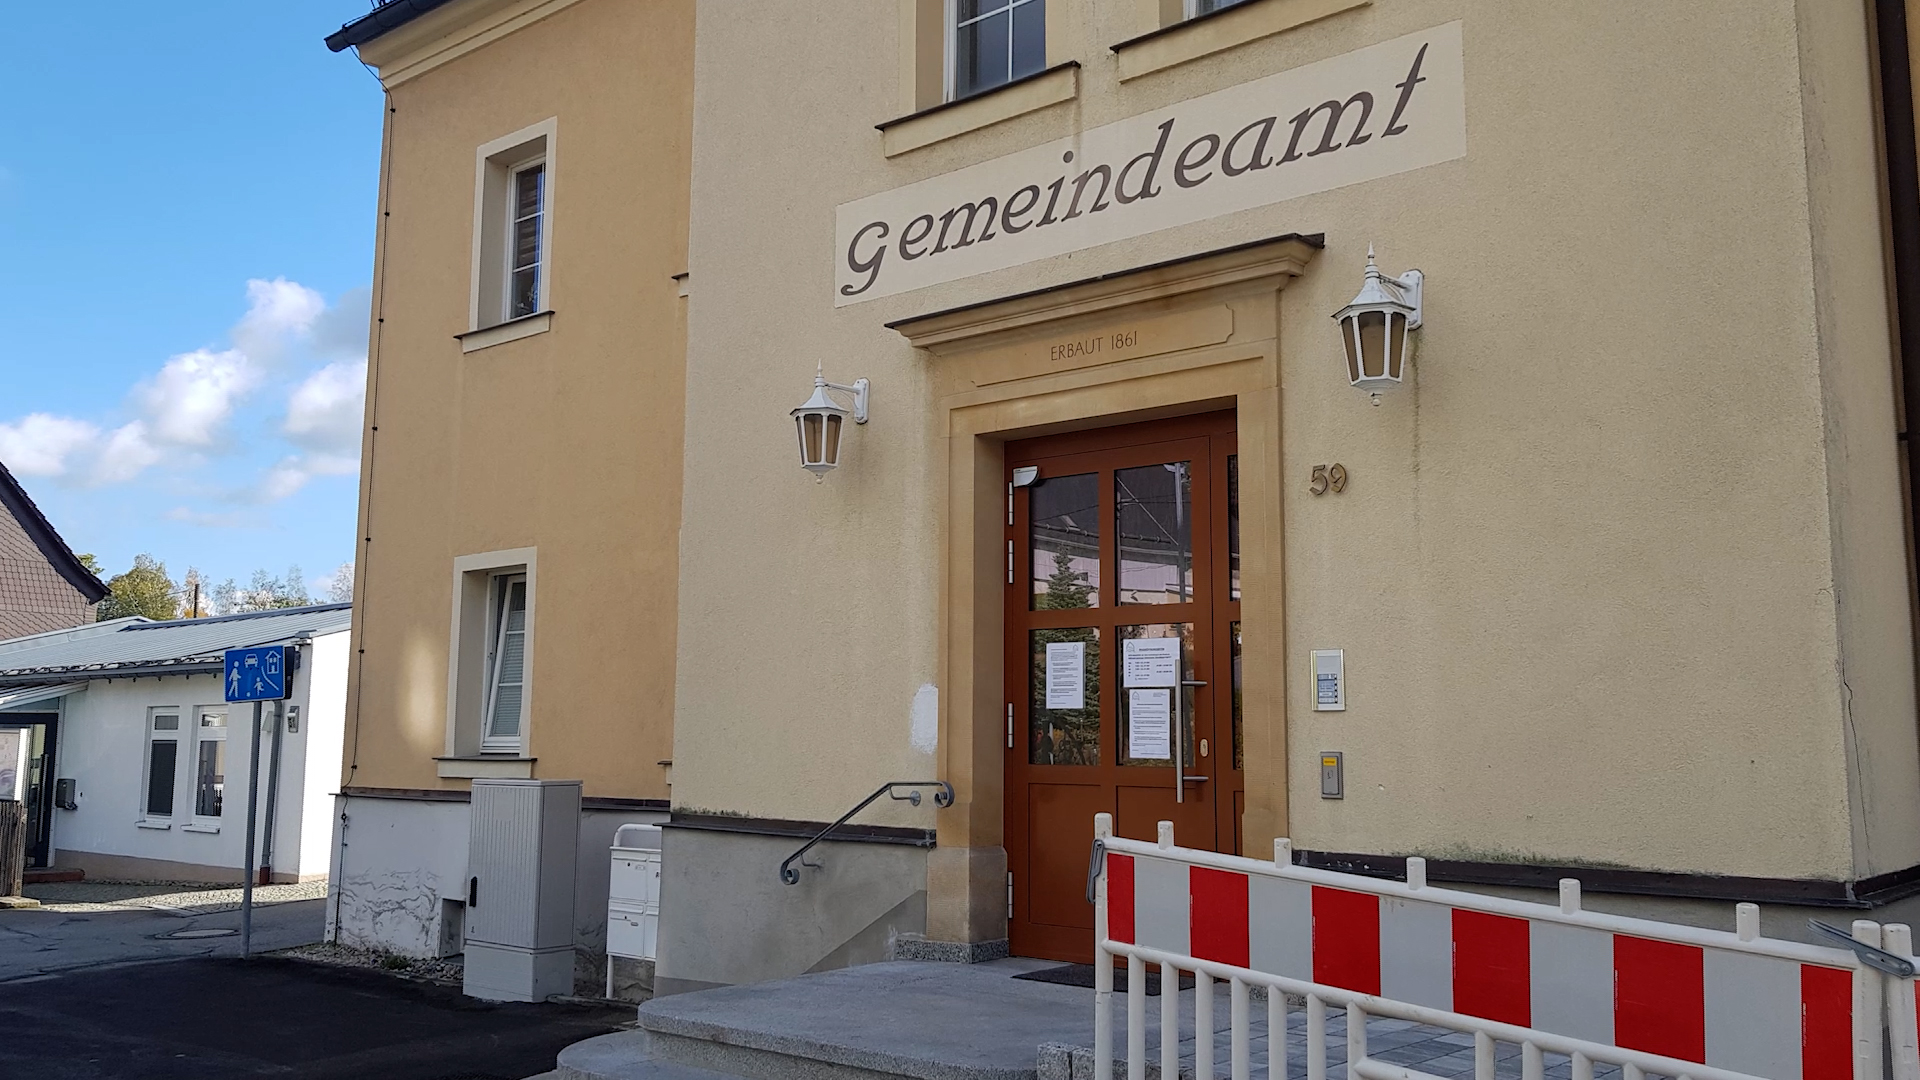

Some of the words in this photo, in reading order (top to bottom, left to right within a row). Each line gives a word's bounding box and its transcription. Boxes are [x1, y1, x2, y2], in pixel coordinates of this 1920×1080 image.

[841, 43, 1428, 296] Gemeindeamt
[1051, 337, 1103, 361] ERBAUT
[1111, 330, 1138, 350] 1861
[1309, 463, 1347, 496] 59
